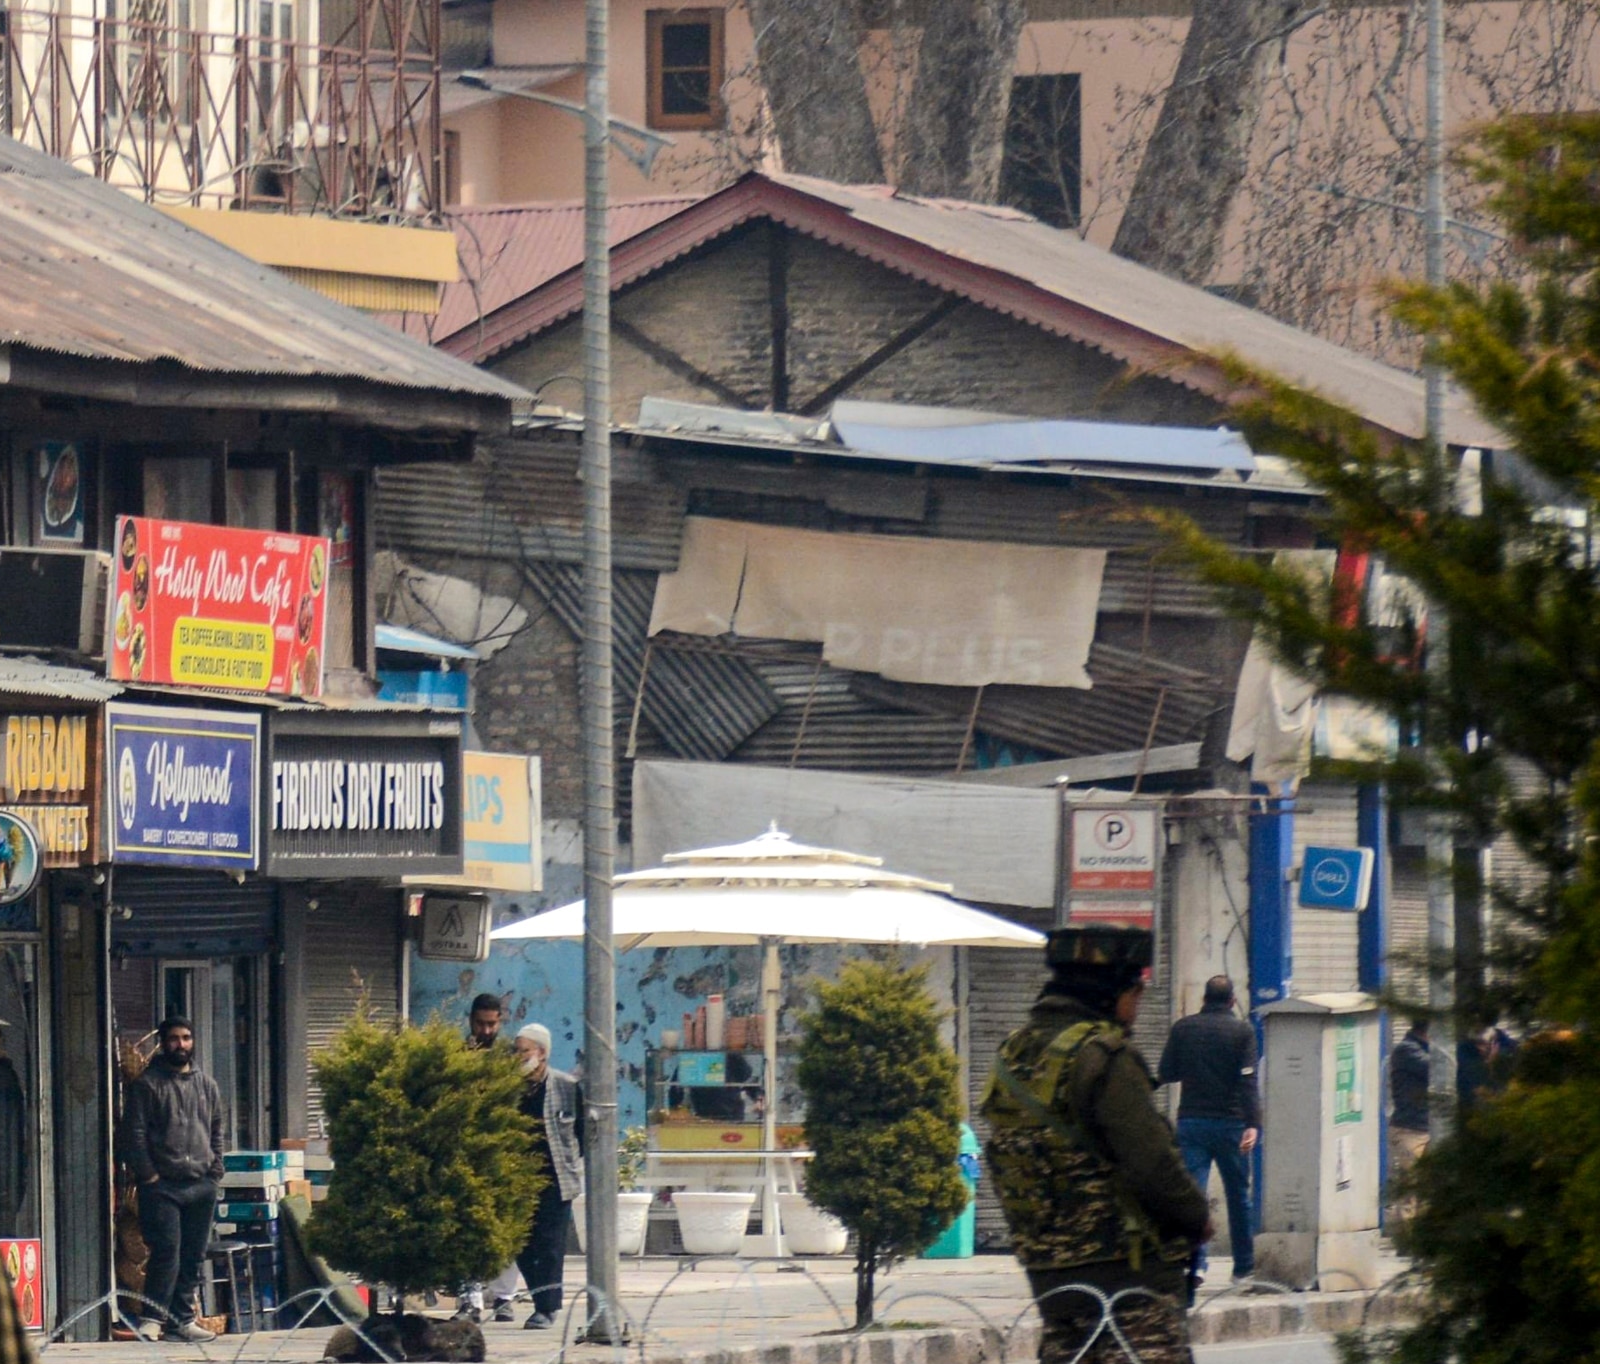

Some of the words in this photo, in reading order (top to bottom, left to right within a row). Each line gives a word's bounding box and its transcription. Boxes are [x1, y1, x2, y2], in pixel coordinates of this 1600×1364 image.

[155, 545, 203, 616] Holly
[204, 549, 248, 604] Wood
[6, 715, 87, 803] RIBBON
[146, 740, 234, 823] Hollywood
[272, 759, 345, 830] FIRDOUS
[347, 761, 382, 830] DRY
[384, 761, 444, 830] FRUITS
[37, 805, 88, 852] SWEETS
[1080, 857, 1098, 867] NO
[1100, 855, 1149, 866] PARKING
[1107, 820, 1124, 843] P
